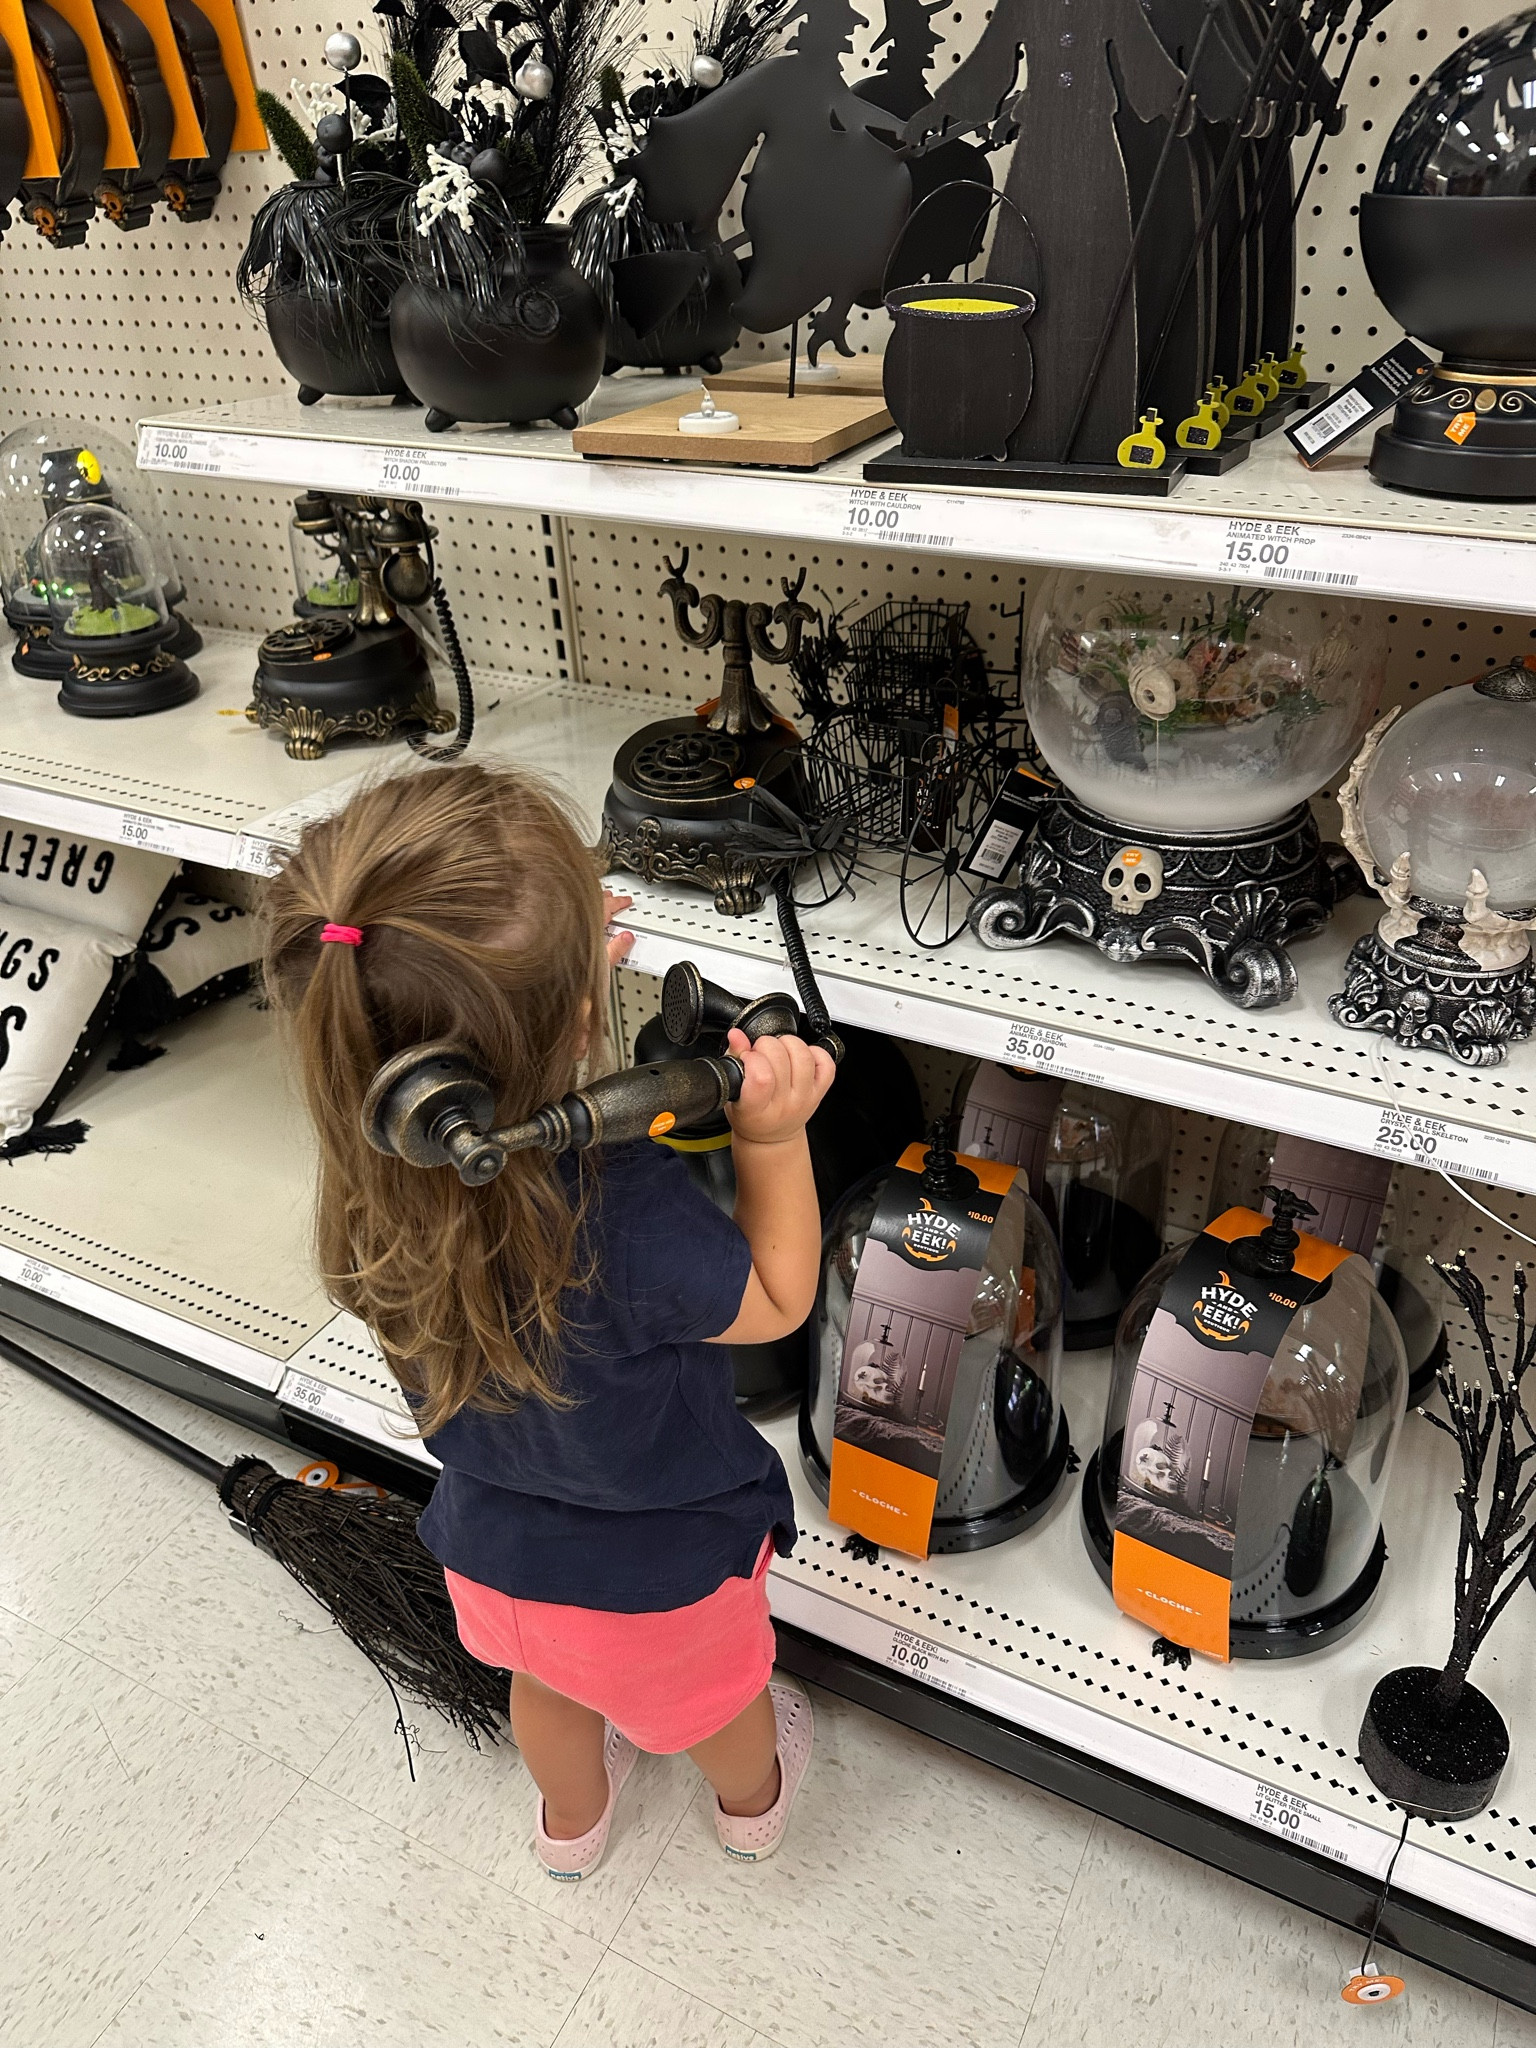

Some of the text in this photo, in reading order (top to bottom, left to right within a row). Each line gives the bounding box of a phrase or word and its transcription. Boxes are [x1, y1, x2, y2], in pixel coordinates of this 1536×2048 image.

[1451, 417, 1463, 432] TRY
[1458, 424, 1470, 436] ME
[155, 444, 188, 459] 10.00
[385, 449, 427, 459] HYDE & EEK
[383, 464, 420, 481] 10.00
[851, 489, 908, 501] HYDE & EEK
[887, 502, 921, 510] CAULDRON
[848, 507, 899, 529] 10.00
[1226, 532, 1265, 540] ANIMATED
[1267, 535, 1292, 543] WITCH
[1229, 521, 1300, 536] HYDE & EEK
[1226, 541, 1289, 564] 15.00
[122, 825, 148, 840] 15.00
[250, 851, 277, 868] 15.0
[1009, 1030, 1068, 1048] ANIMATED FISHBOWL
[1011, 1023, 1035, 1035] HYDE
[1045, 1031, 1063, 1041] EEK
[1006, 1037, 1055, 1061] 35.00
[1382, 1110, 1447, 1132] HYDE & EEK
[1376, 1126, 1437, 1154] 25.00
[1413, 1126, 1430, 1134] BALL
[1432, 1131, 1468, 1143] SKELETON
[907, 1213, 962, 1238] HYDE
[968, 1211, 994, 1223] $10.00
[911, 1230, 947, 1249] EEK!
[21, 1268, 43, 1283] 10.00
[1201, 1287, 1258, 1319] HYDE
[1269, 1292, 1297, 1309] $10.00
[1202, 1304, 1240, 1329] EEK!
[300, 1376, 314, 1385] HYDE
[318, 1383, 328, 1391] EEK
[293, 1387, 321, 1405] 35.00
[859, 1491, 901, 1514] CLOCHE
[1145, 1590, 1193, 1614] CLOCHE
[893, 1637, 911, 1648] CLOCHE
[912, 1645, 927, 1655] BLACK
[927, 1652, 939, 1660] WITH
[895, 1630, 915, 1644] HYDE
[921, 1641, 939, 1654] EEK!
[892, 1644, 928, 1670] 10.00
[1257, 1784, 1308, 1810] HYDE & EEK
[1255, 1800, 1300, 1829] 15.00
[1265, 1795, 1287, 1808] GLITTER
[1288, 1804, 1302, 1814] TREE
[1303, 1811, 1321, 1823] SMALL
